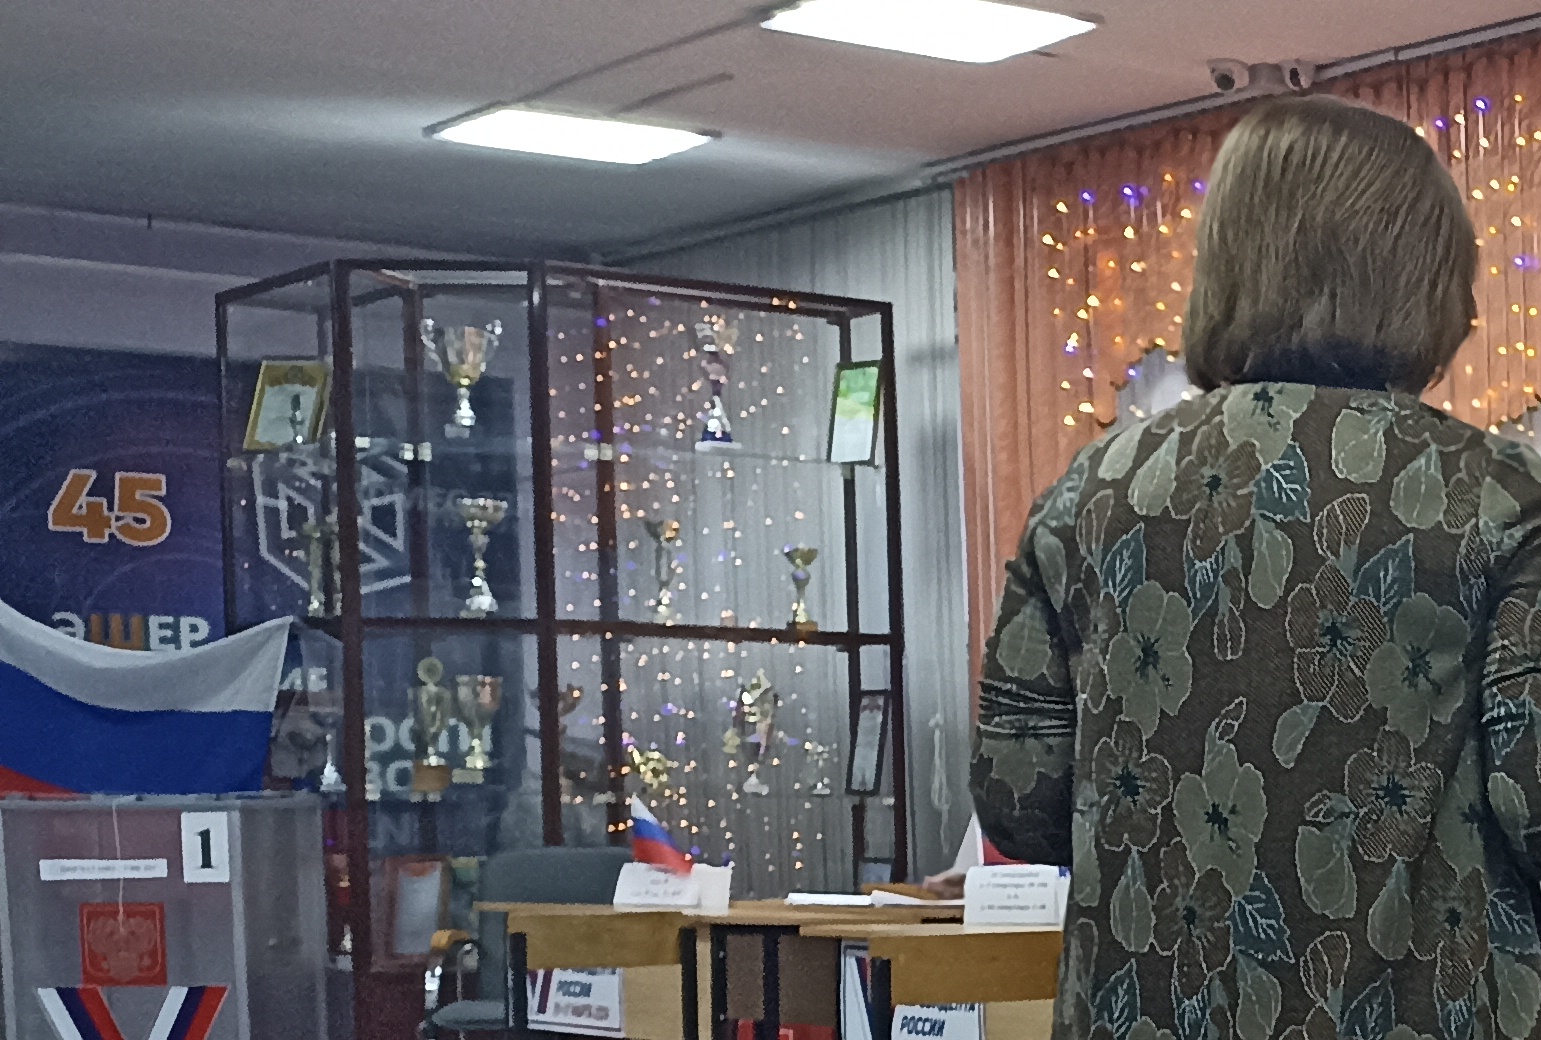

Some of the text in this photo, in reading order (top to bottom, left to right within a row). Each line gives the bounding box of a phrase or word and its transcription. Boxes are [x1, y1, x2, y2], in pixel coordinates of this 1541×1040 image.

[48, 468, 171, 547] 45
[194, 828, 218, 869] 1
[900, 1015, 946, 1037] РОССИИ
